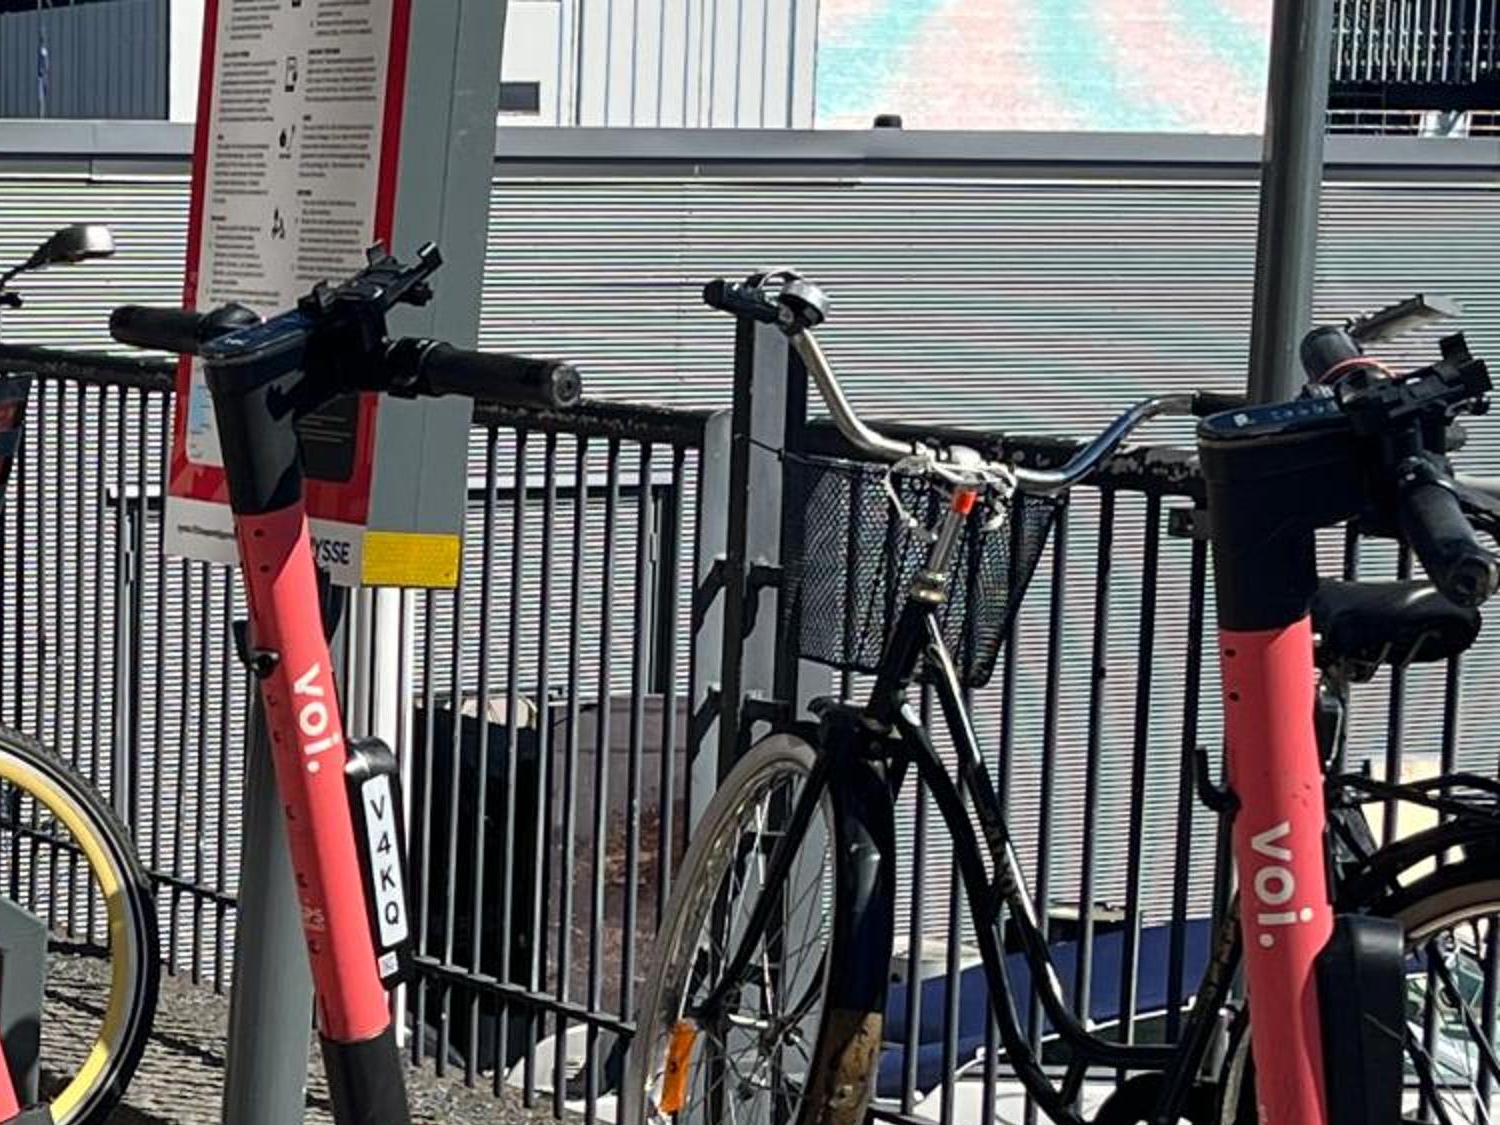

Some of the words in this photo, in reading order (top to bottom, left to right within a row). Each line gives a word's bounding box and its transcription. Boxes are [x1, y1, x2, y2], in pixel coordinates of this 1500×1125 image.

[310, 536, 351, 565] YSSE
[293, 664, 341, 774] voi.
[1251, 821, 1314, 947] voi.
